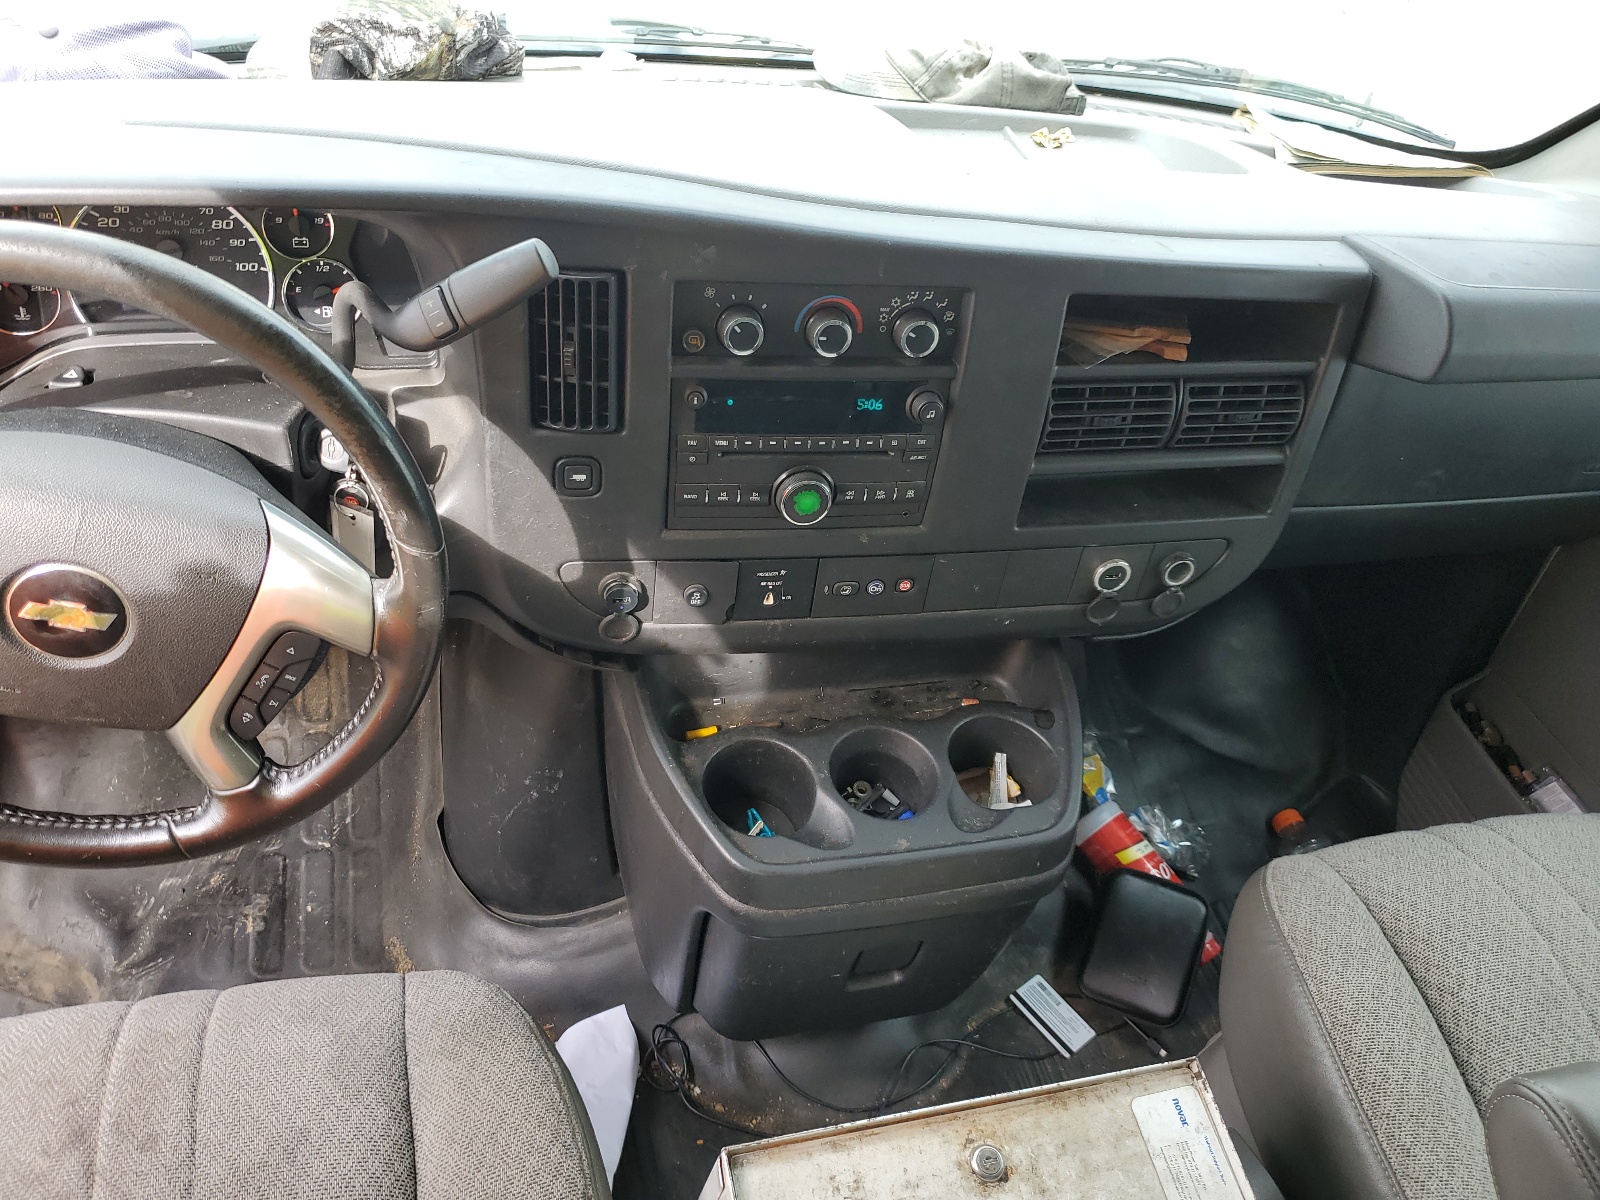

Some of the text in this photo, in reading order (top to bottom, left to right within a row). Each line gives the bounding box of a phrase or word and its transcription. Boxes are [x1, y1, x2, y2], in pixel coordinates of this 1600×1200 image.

[113, 205, 130, 213] 30
[199, 207, 214, 215] 70
[97, 217, 120, 228] 20
[211, 219, 234, 230] 80
[314, 217, 325, 225] 19
[155, 228, 181, 236] km/h
[229, 238, 246, 247] 90
[235, 261, 259, 272] 100
[856, 398, 884, 411] 5:06
